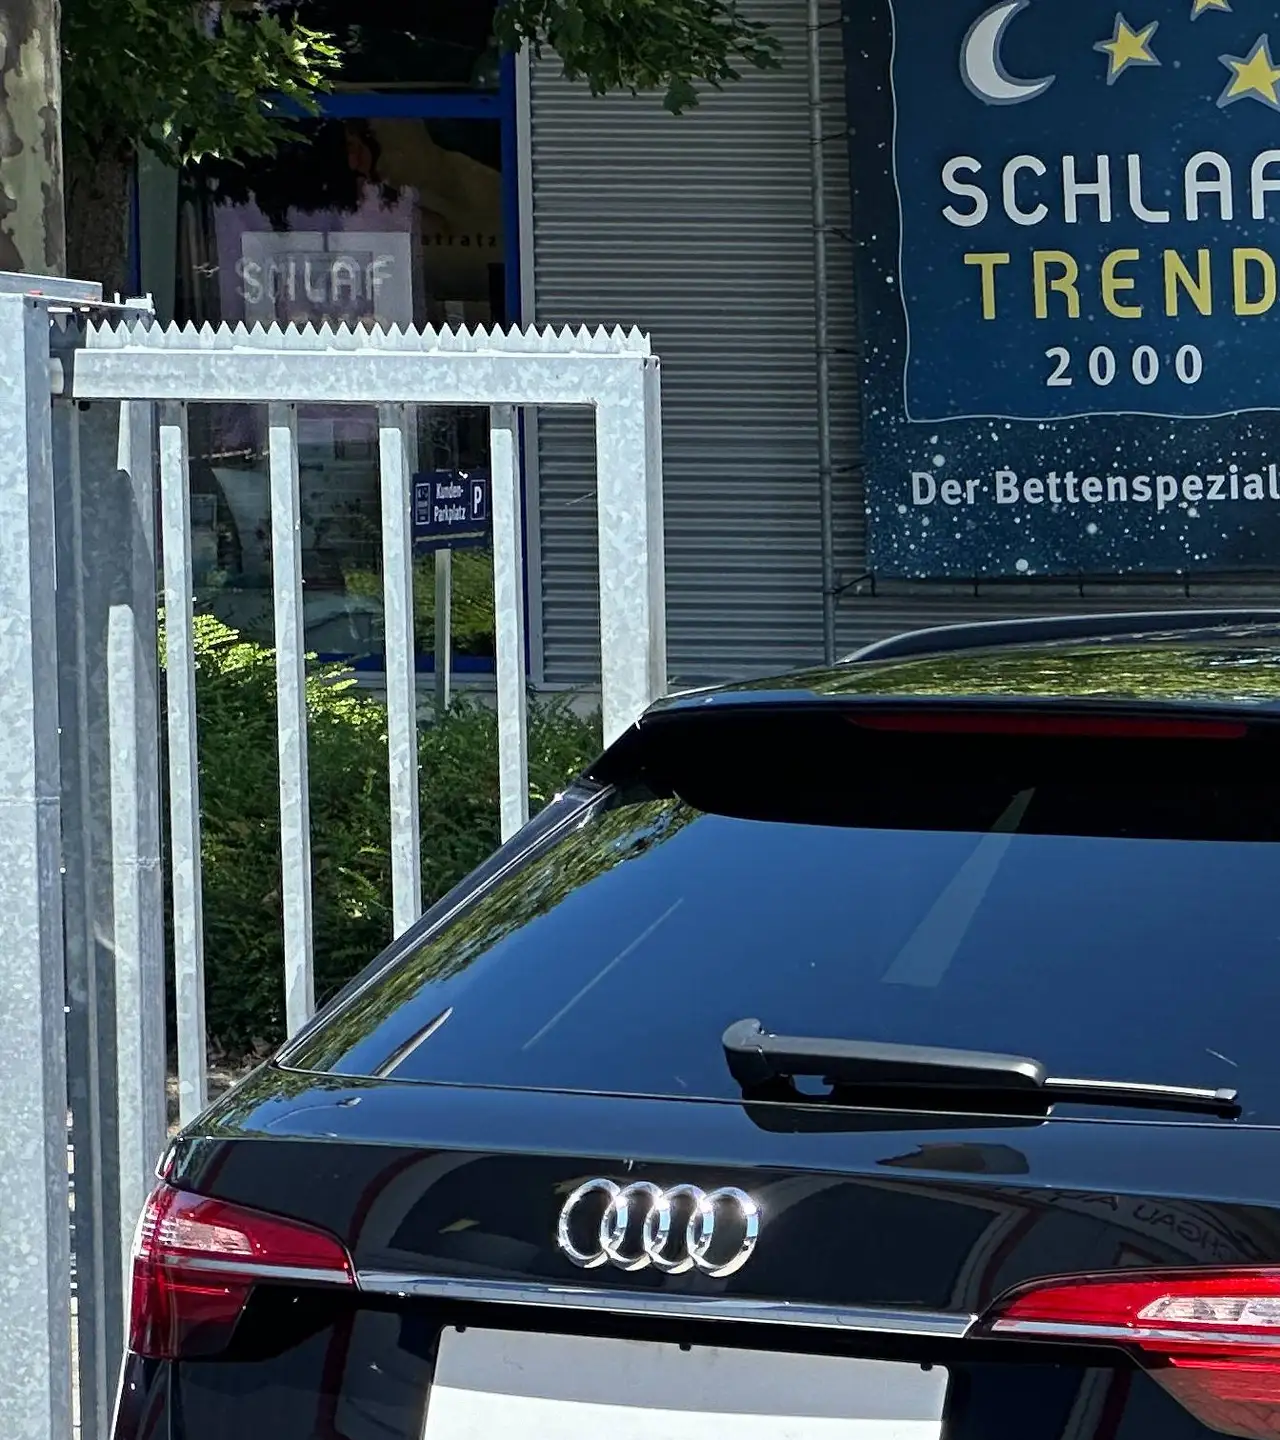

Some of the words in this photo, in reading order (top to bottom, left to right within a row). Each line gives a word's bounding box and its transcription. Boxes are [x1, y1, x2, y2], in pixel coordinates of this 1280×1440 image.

[963, 247, 1278, 320] TREND
[1044, 343, 1204, 388] 2000
[436, 481, 464, 499] Kunden-
[911, 470, 981, 506] Der
[434, 503, 466, 525] Parkplatz
